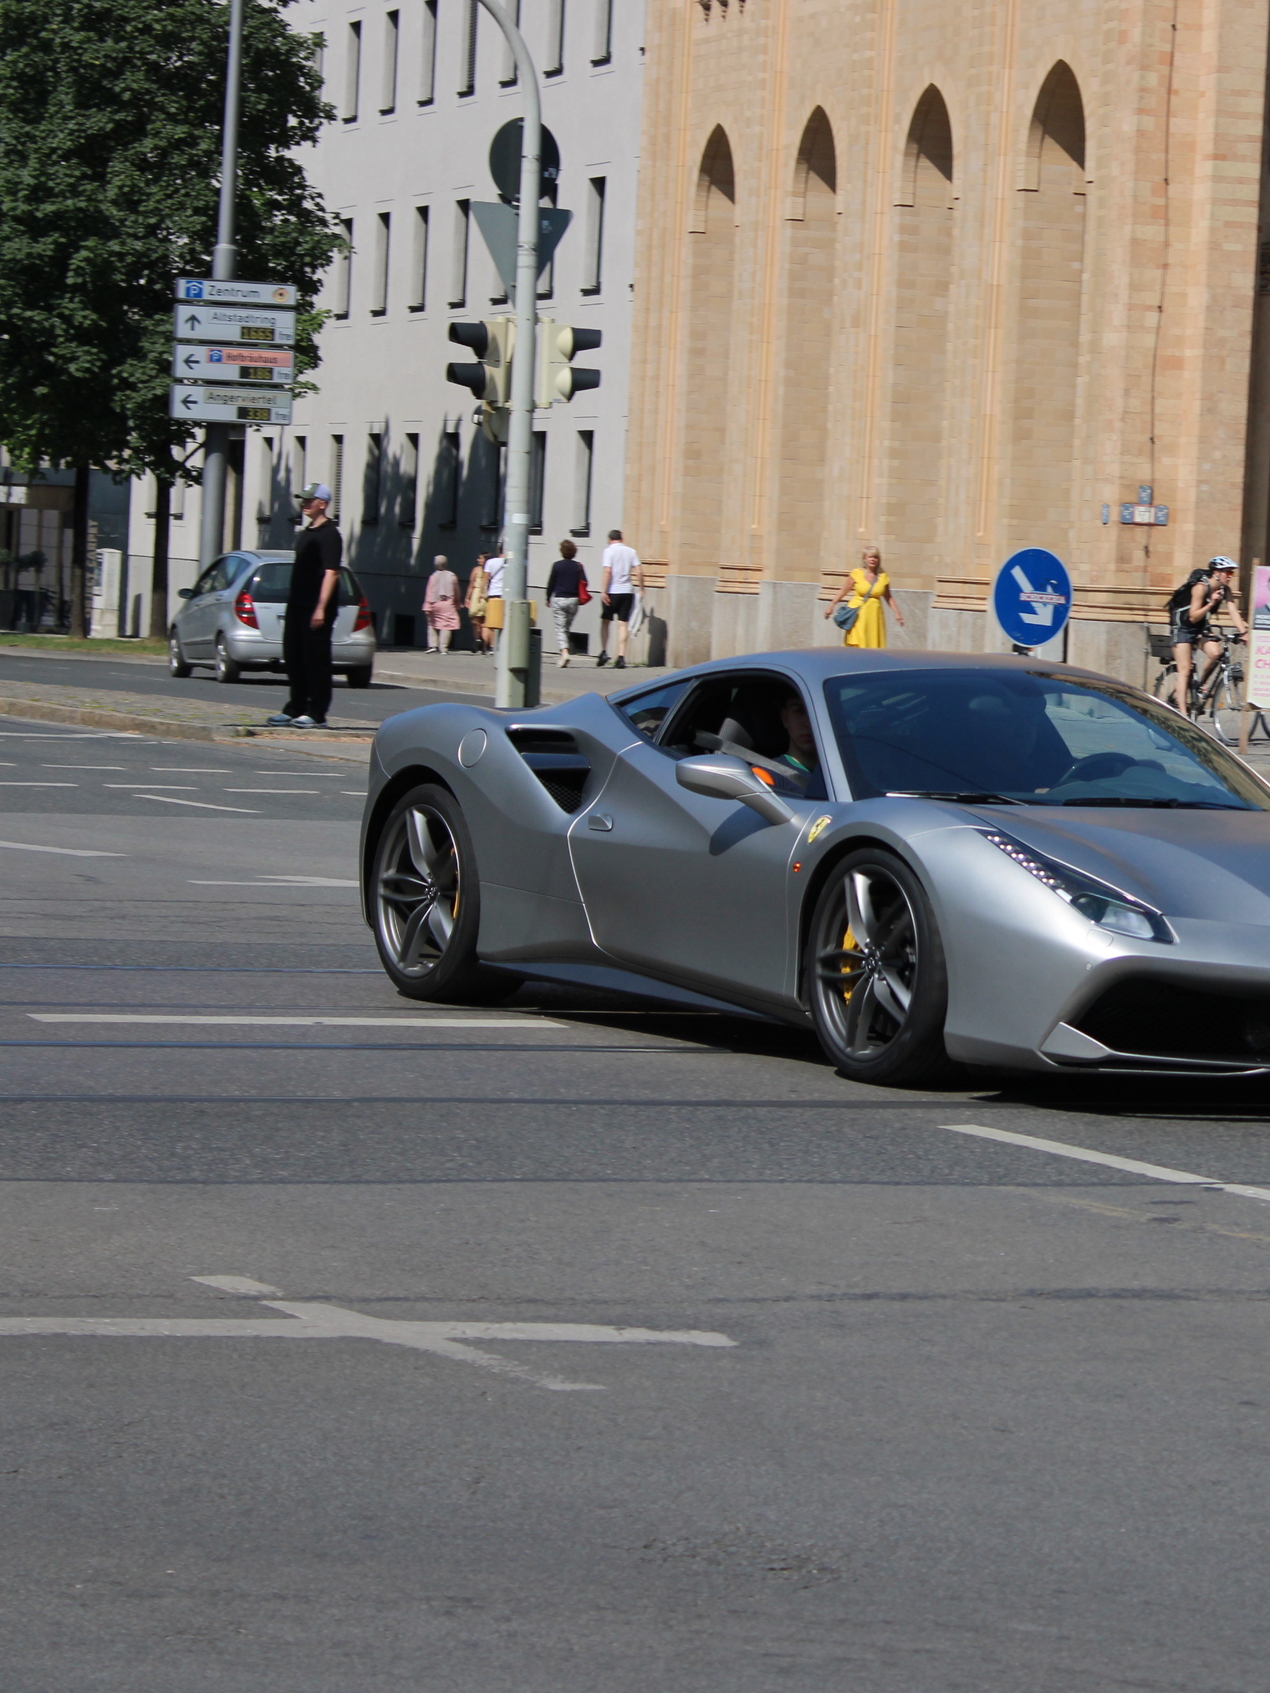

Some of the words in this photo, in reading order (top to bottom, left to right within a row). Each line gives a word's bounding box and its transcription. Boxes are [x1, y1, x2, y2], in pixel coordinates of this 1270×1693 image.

[208, 285, 260, 299] Zentrum
[212, 311, 276, 327] Altstadtring
[278, 331, 292, 341] frei
[226, 352, 278, 364] Hofbräuhaus
[277, 371, 290, 380] frei
[208, 391, 277, 406] Angerviertel
[274, 410, 288, 421] frei
